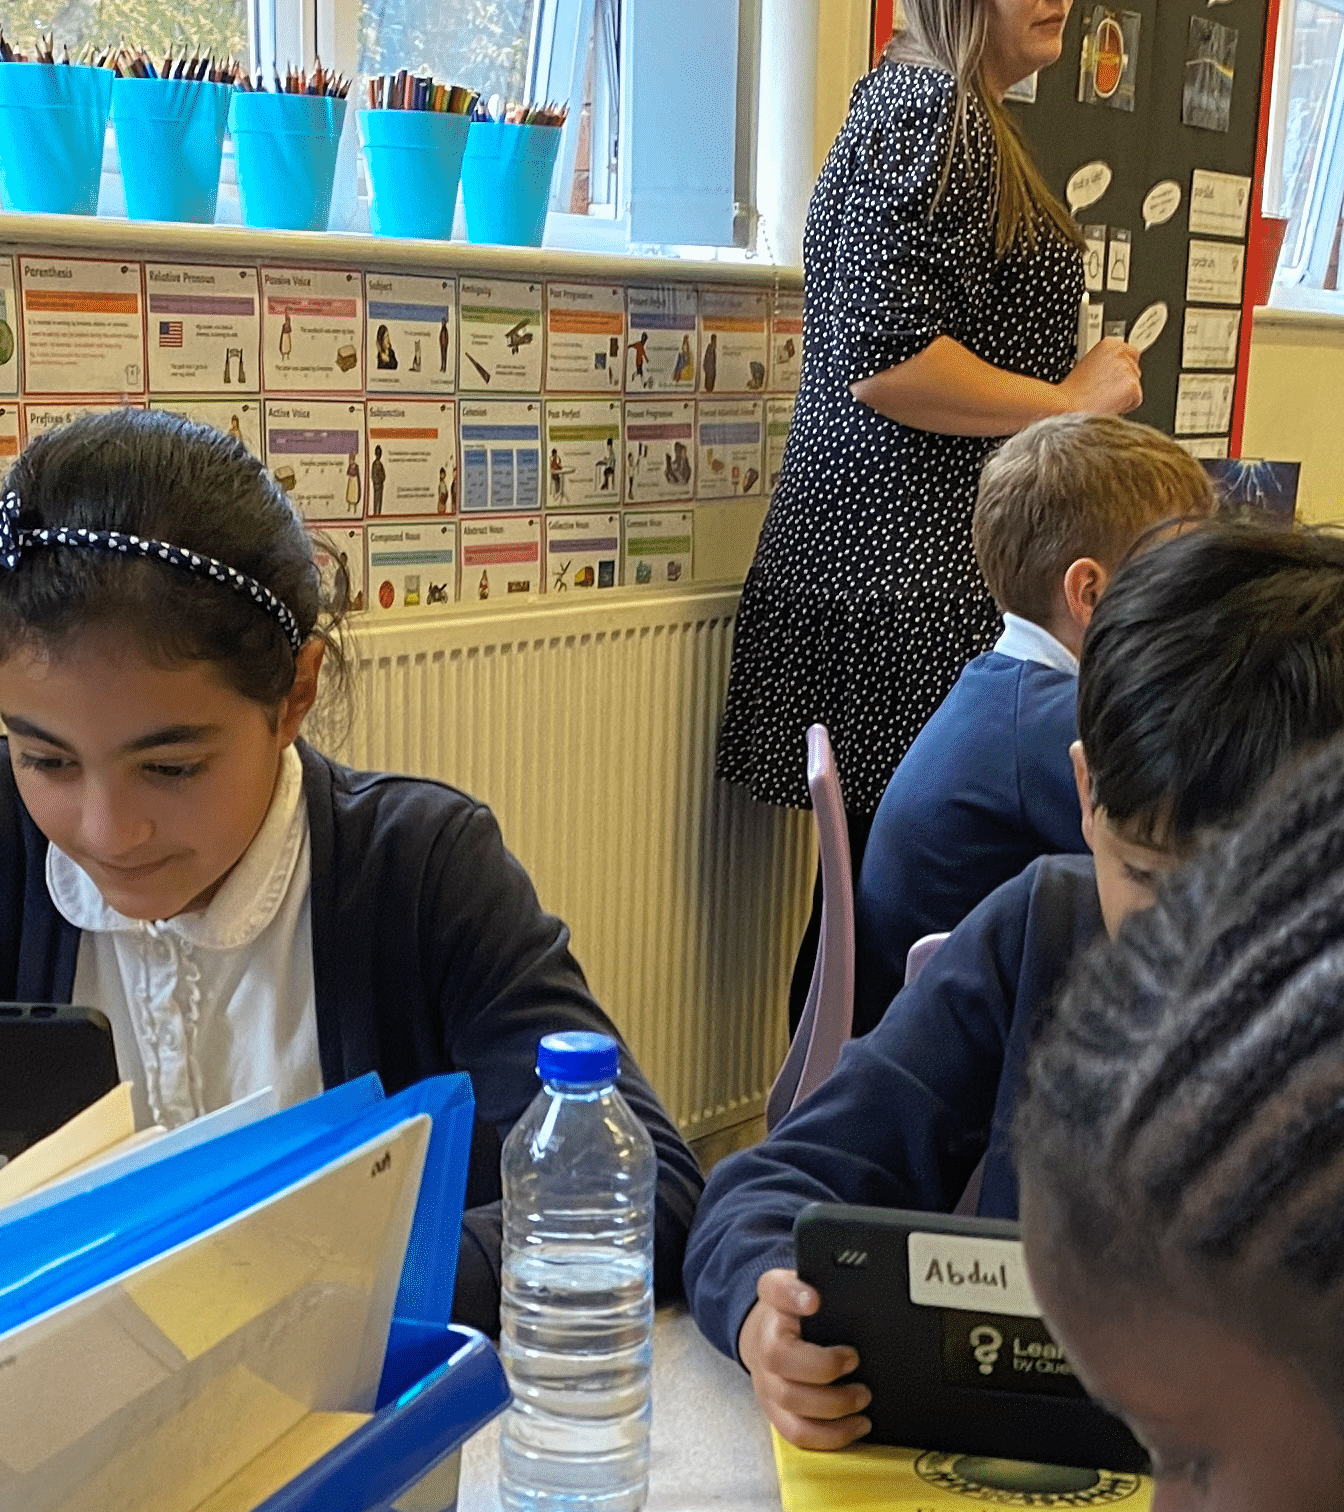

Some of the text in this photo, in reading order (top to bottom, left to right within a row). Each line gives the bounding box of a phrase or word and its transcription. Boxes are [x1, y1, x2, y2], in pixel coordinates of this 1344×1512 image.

[24, 266, 73, 278] Parenthesis
[149, 271, 216, 285] Relative Pronoun
[264, 275, 311, 287] Passive Voice
[368, 281, 392, 292] Subject
[461, 284, 492, 297] Ambiguity
[30, 412, 62, 424] Prefixes
[268, 408, 310, 419] Active Voice
[369, 407, 405, 420] Subjunctive
[462, 407, 487, 417] Cohesion
[547, 408, 581, 419] Past Perfect
[463, 525, 504, 536] Abstract Noun
[370, 532, 404, 543] Compound
[924, 1258, 1008, 1289] Abdul
[1013, 1336, 1065, 1360] Lear
